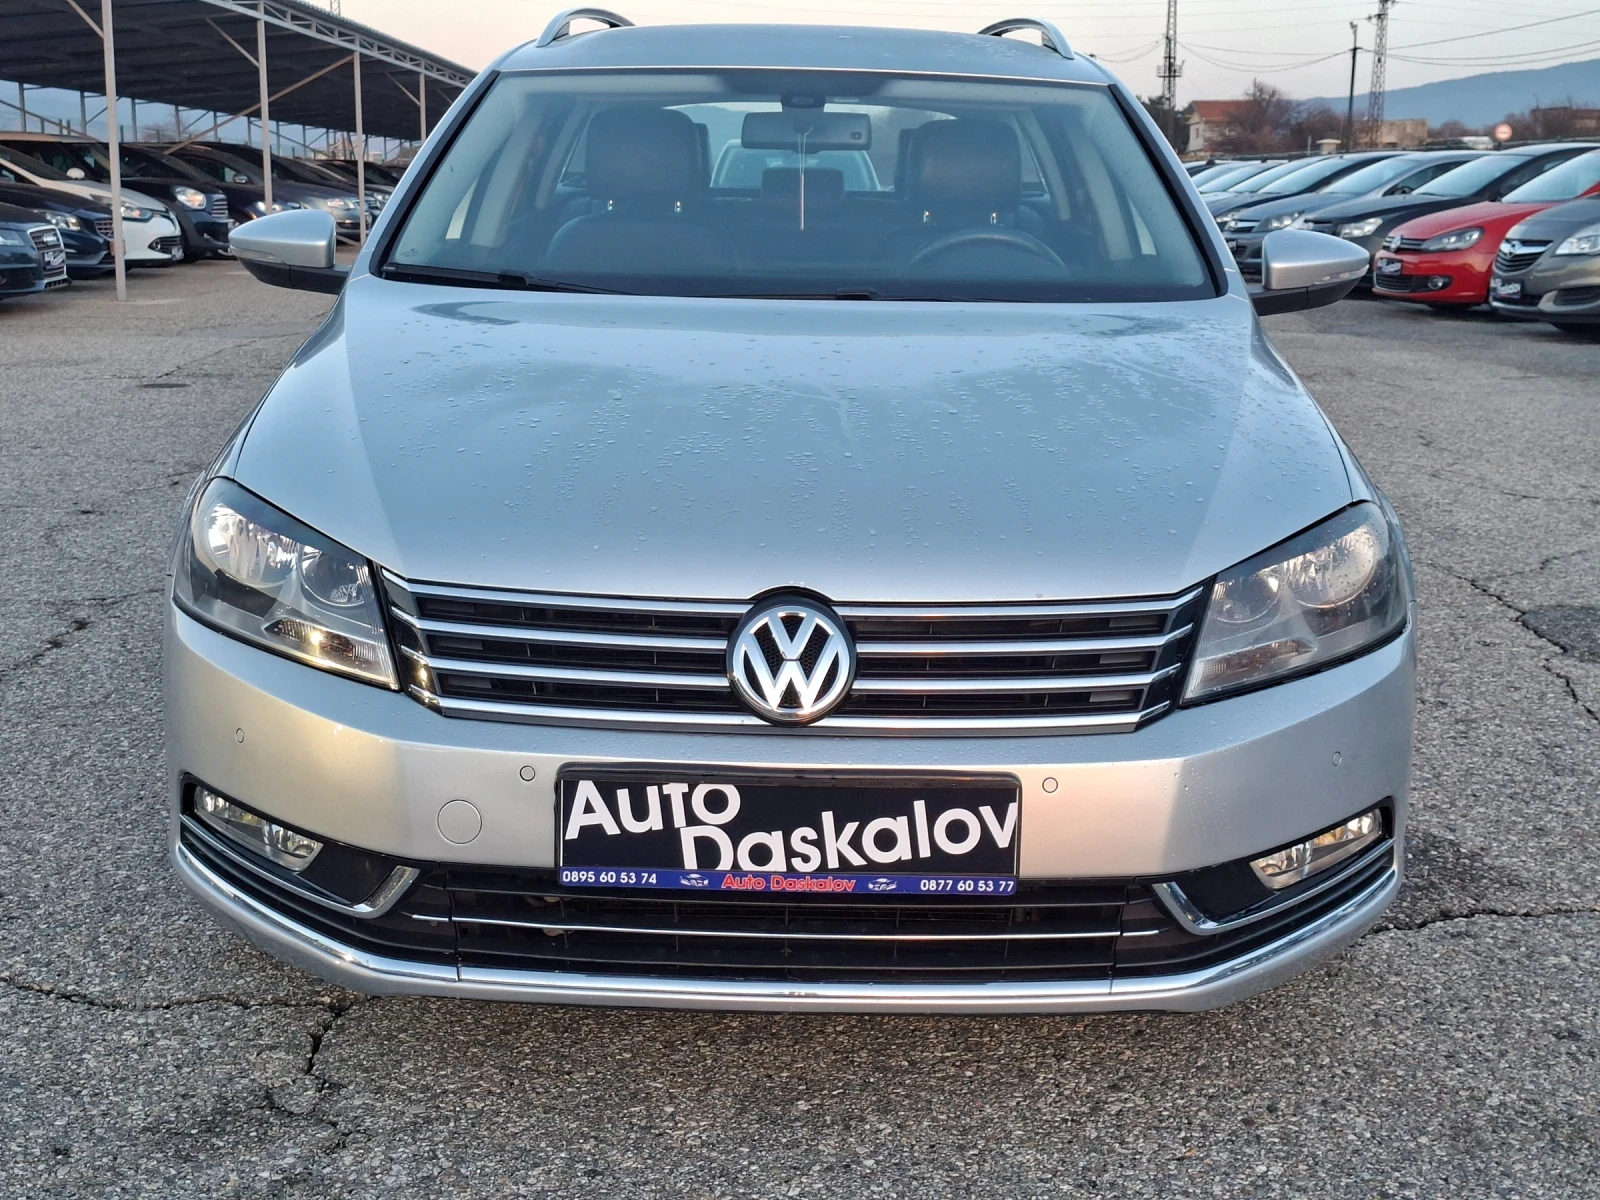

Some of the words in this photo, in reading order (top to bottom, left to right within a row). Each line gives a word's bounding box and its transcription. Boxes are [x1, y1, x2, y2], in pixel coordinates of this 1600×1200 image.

[733, 606, 850, 714] VW
[565, 780, 740, 840] Auto
[679, 800, 1017, 872] Daskalov
[562, 871, 596, 883] 0895
[599, 871, 616, 884] 60
[620, 872, 636, 884] 53
[641, 873, 657, 885] 74
[721, 873, 766, 890] Auto
[770, 875, 856, 892] Daskalov
[920, 879, 952, 891] 0877
[957, 880, 974, 892] 60
[977, 880, 994, 892] 53
[998, 881, 1014, 893] 77
